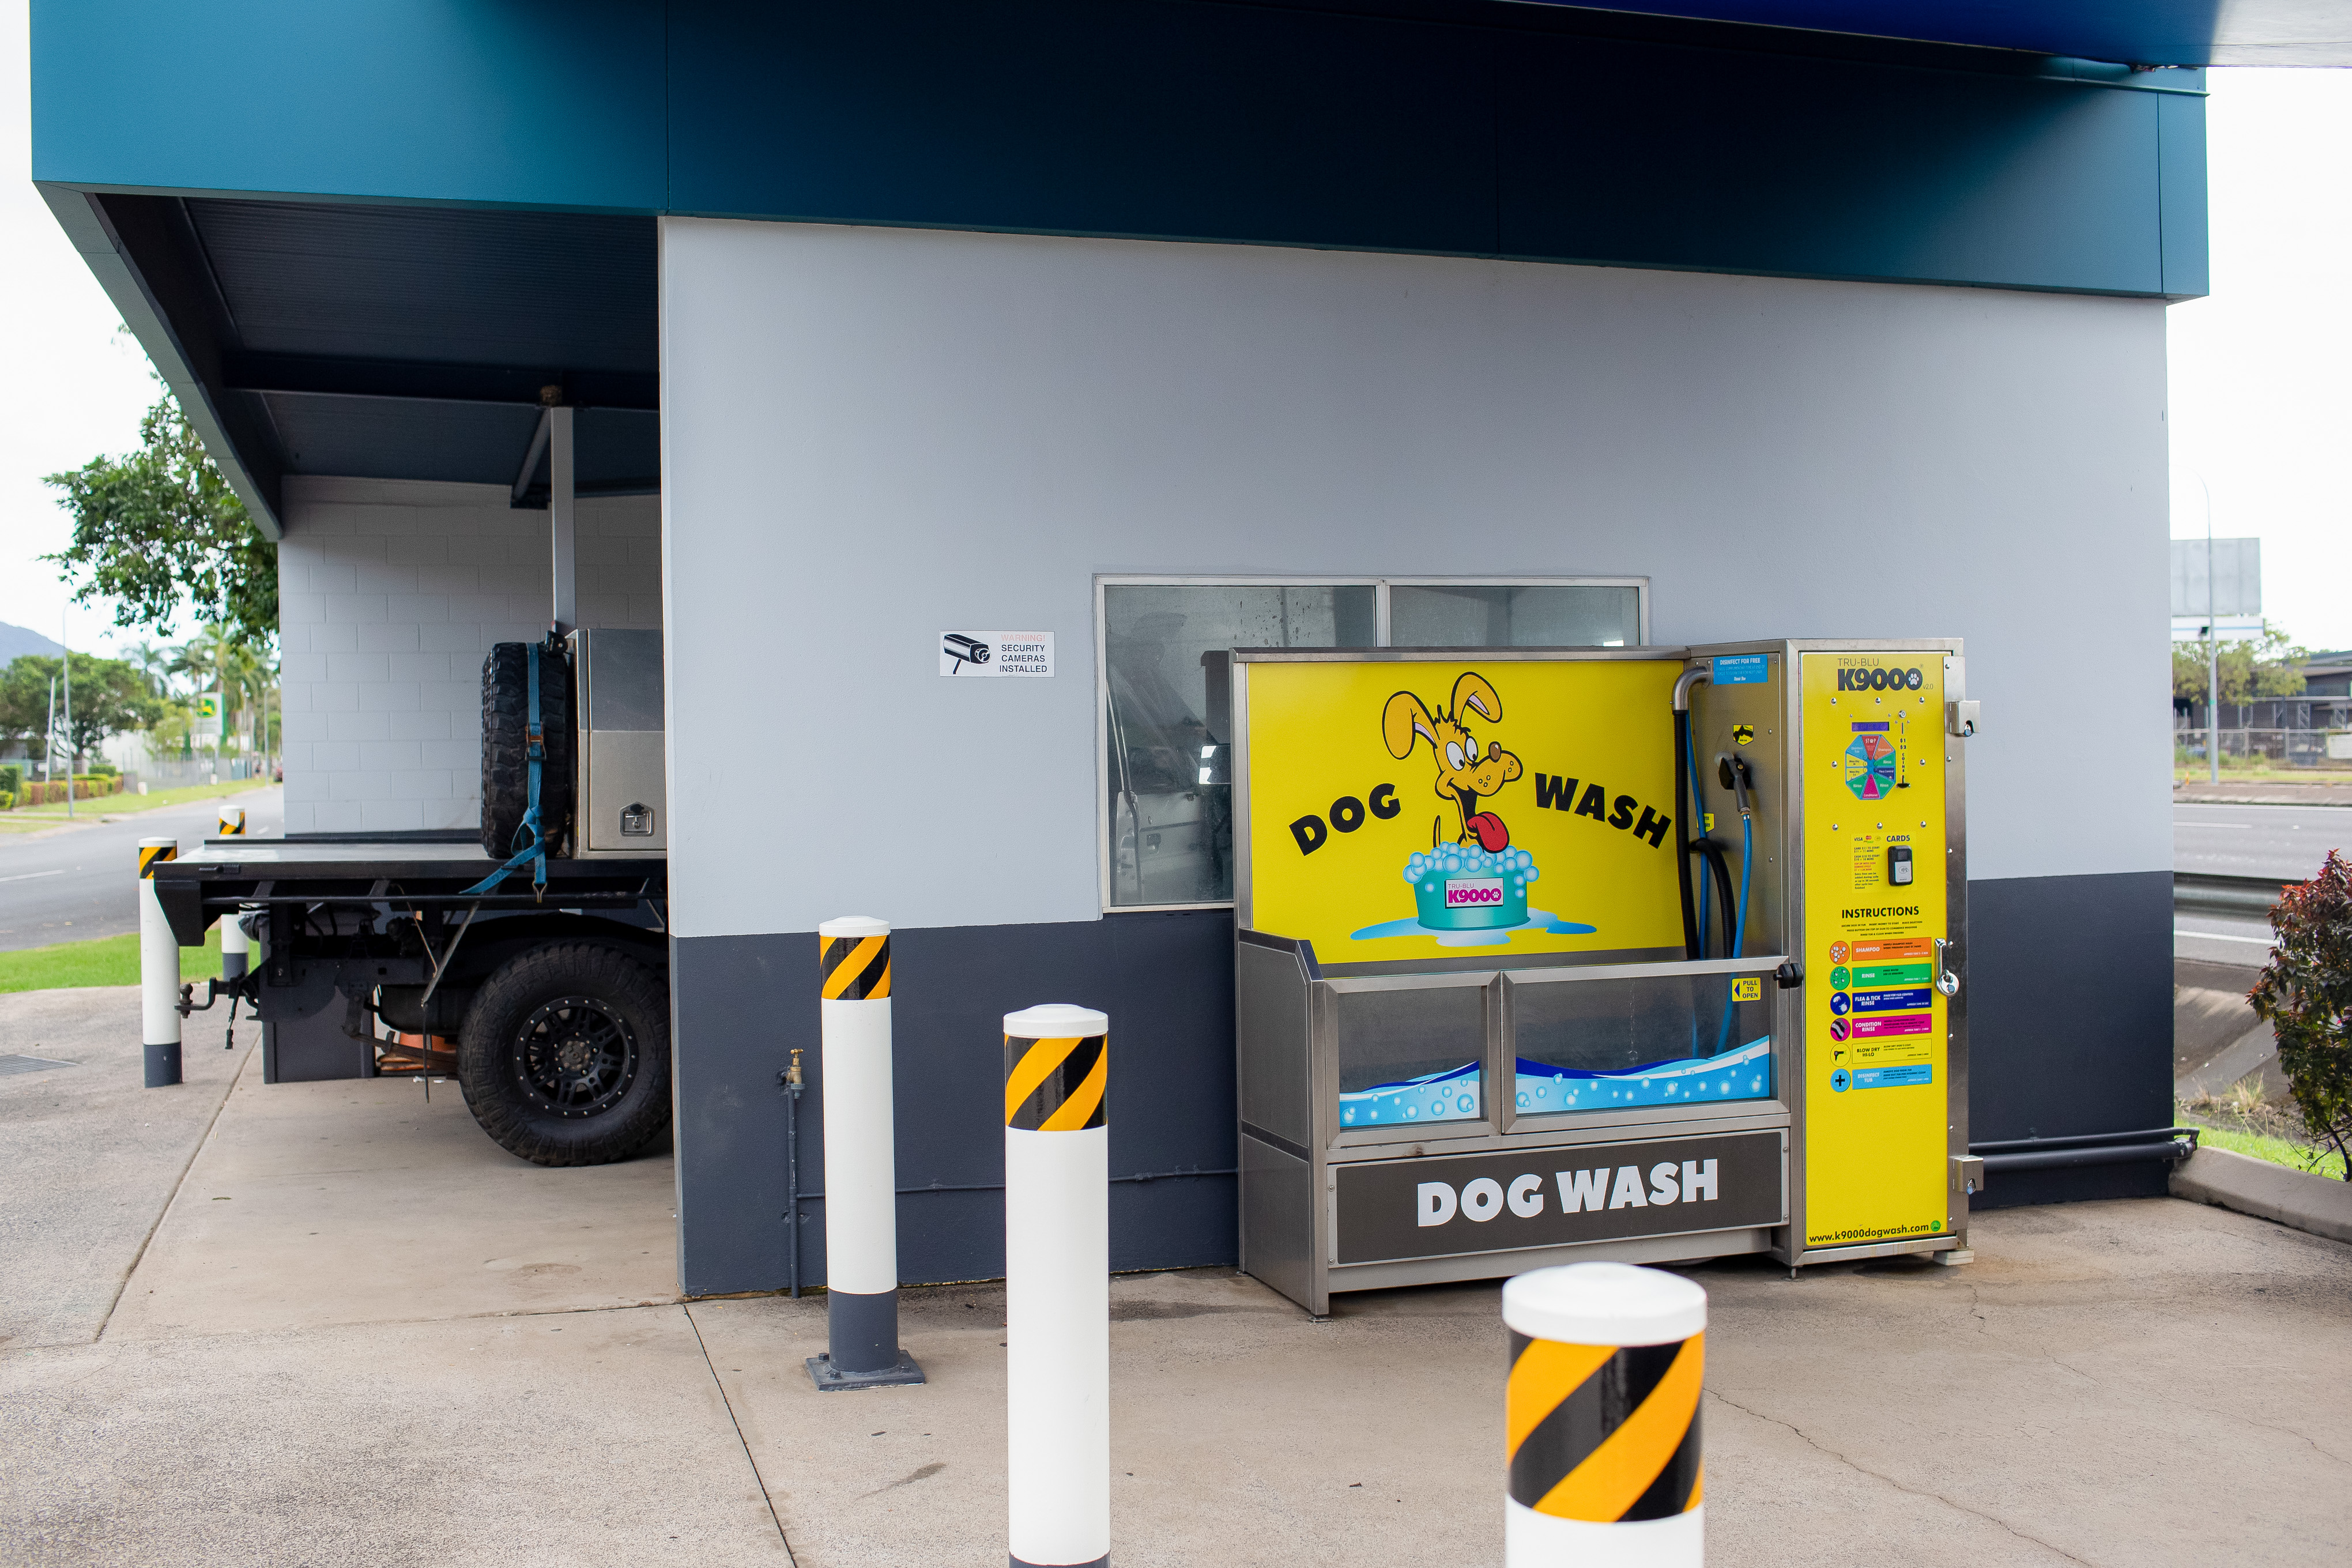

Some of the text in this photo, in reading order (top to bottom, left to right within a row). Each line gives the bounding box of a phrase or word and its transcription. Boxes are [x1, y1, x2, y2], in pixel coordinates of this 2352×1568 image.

[1001, 644, 1045, 652] SECURITY
[1001, 654, 1045, 662] CAMERAS
[1837, 658, 1879, 666] TRU-BLU
[1000, 665, 1047, 673] INSTALLED
[1837, 668, 1923, 691] K9000
[1288, 772, 1672, 857] DOG WASH
[1448, 888, 1502, 903] K9000
[1841, 906, 1920, 919] INSTRUCTIONS
[1418, 1159, 1718, 1227] DOG WASH
[1809, 1224, 1929, 1242] www.k9000dogwash.com
